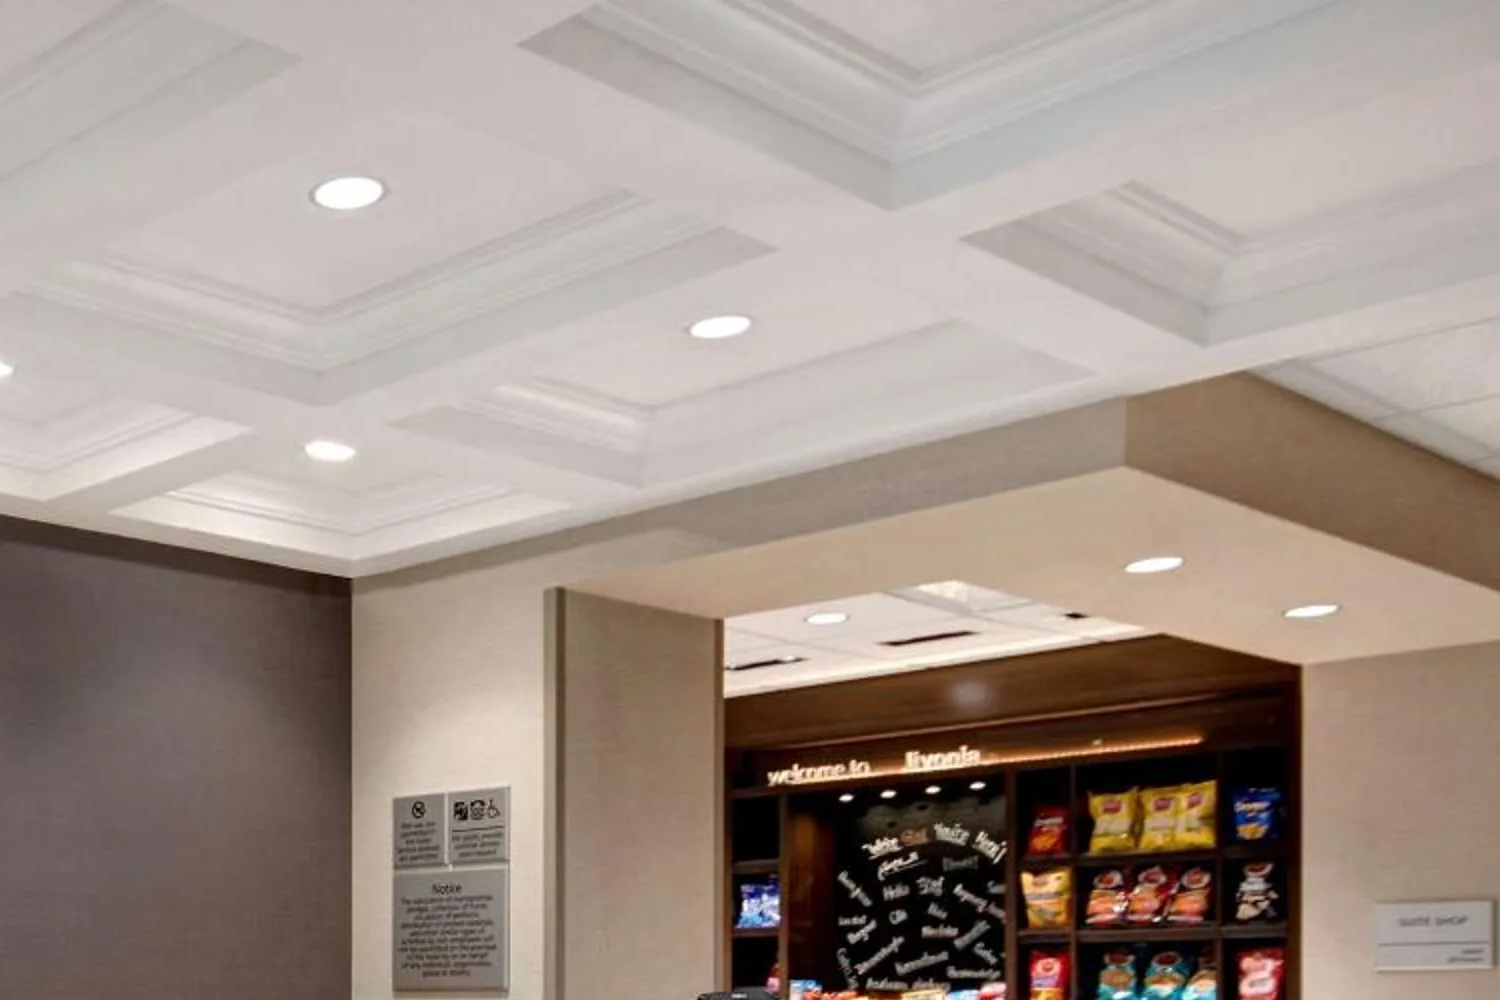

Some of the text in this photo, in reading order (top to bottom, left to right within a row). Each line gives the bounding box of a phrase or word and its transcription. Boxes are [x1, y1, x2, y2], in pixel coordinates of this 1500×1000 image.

[767, 762, 846, 787] welcome
[848, 759, 871, 777] to
[432, 883, 462, 895] Notice
